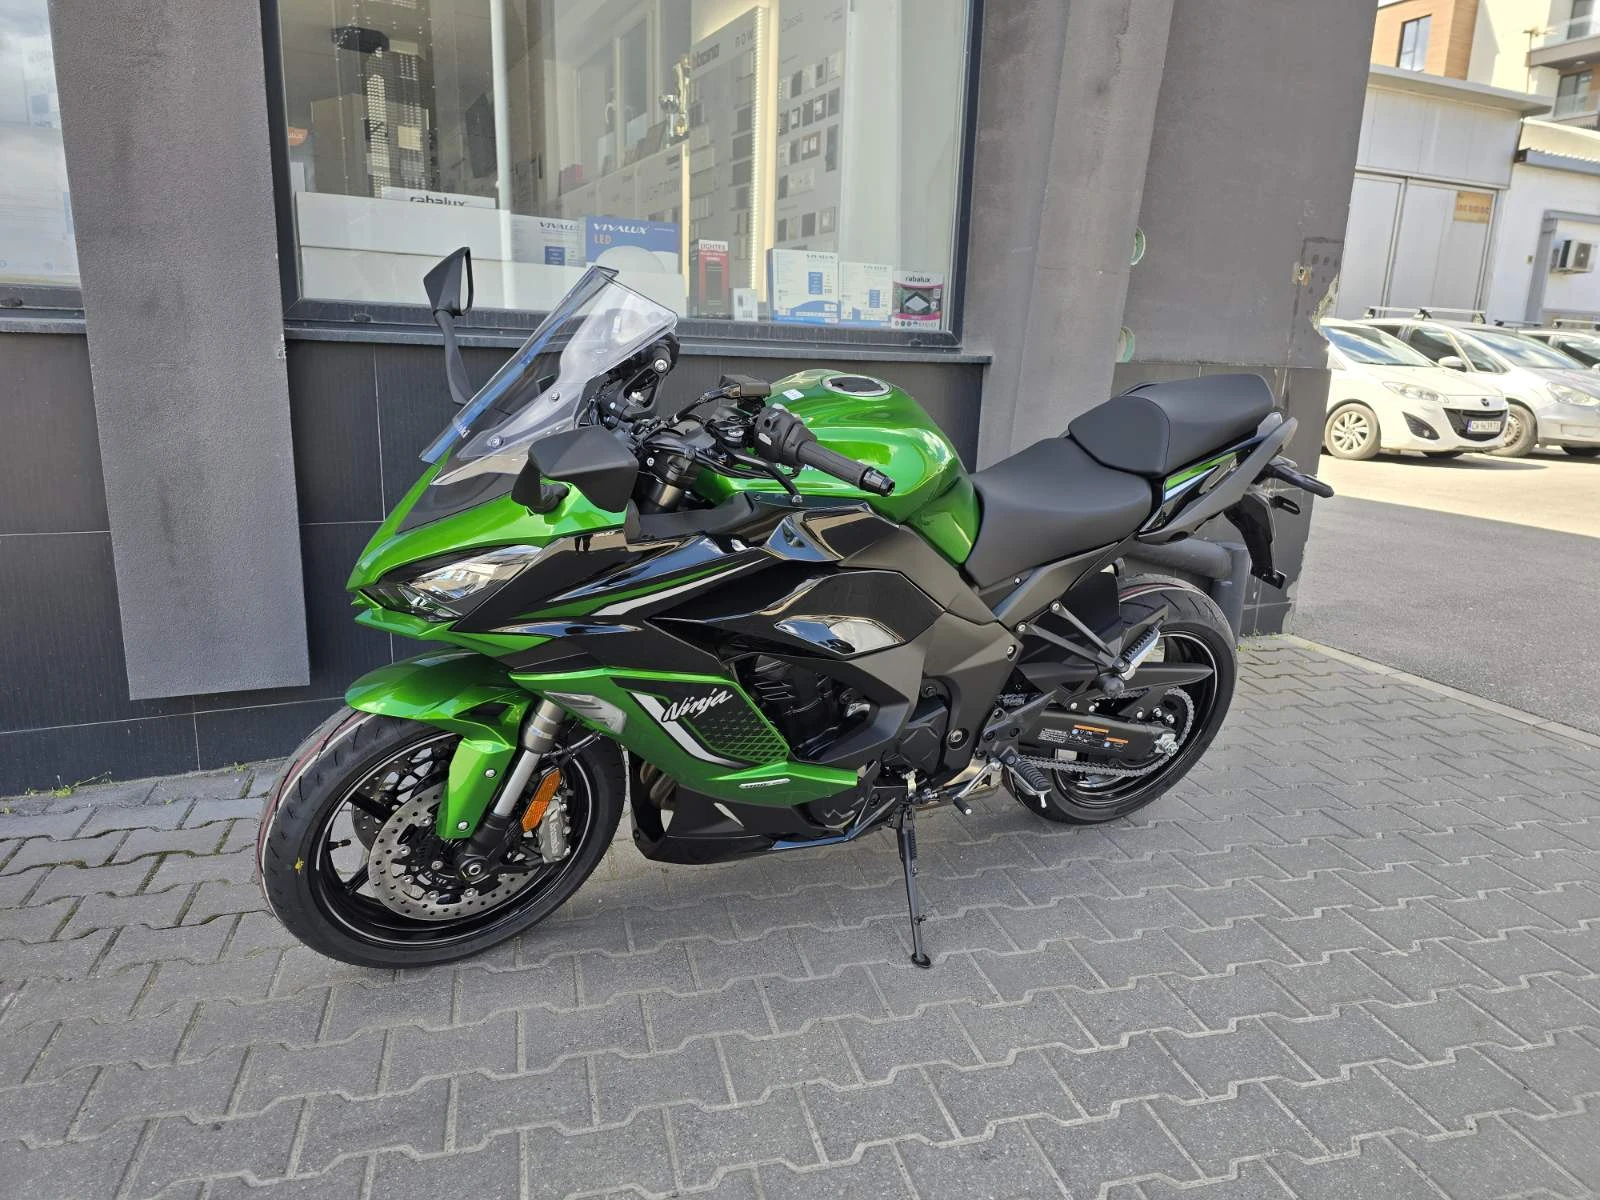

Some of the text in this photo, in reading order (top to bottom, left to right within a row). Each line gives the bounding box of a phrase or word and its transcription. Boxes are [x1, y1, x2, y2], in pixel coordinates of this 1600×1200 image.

[593, 223, 649, 235] VIVALUX
[594, 234, 612, 246] LED
[662, 687, 734, 721] Ninja
